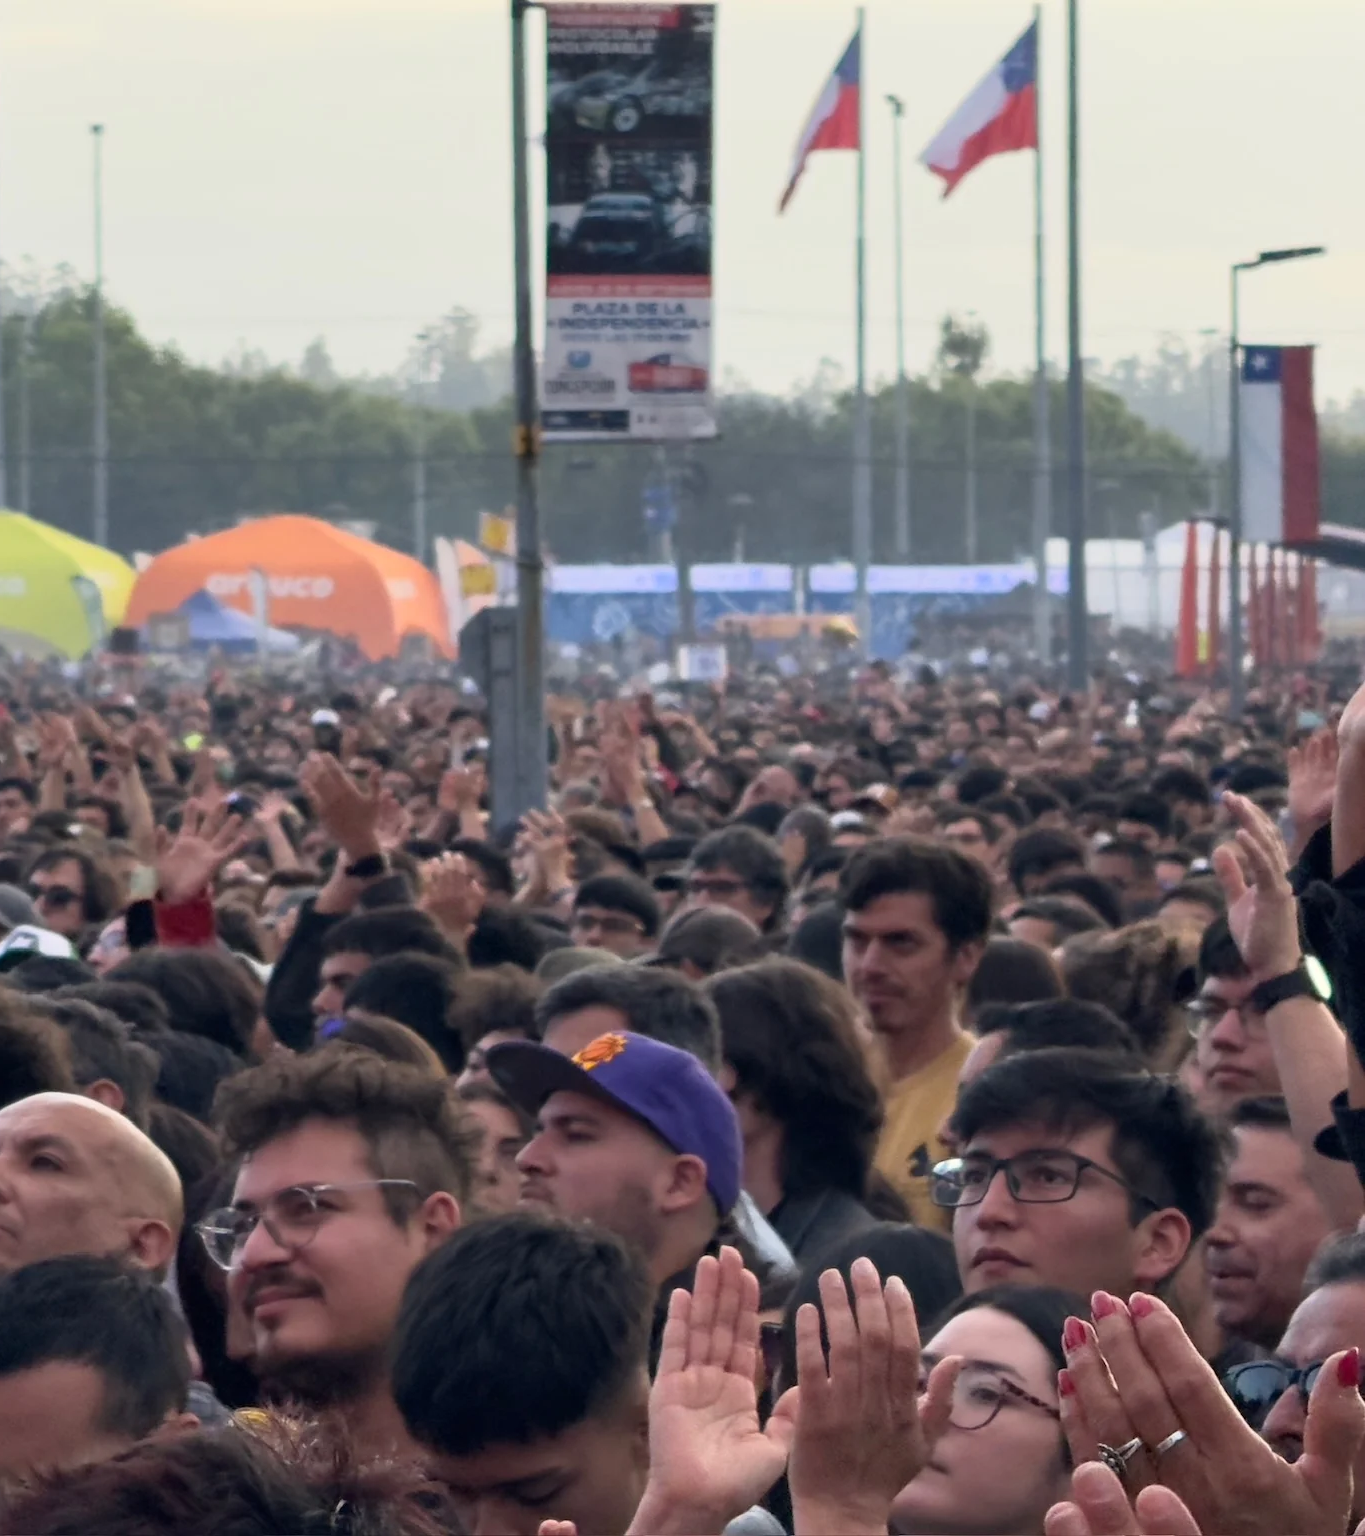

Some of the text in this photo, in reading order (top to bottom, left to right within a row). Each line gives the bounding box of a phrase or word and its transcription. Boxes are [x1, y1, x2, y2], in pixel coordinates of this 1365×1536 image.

[572, 303, 685, 315] PLAZA DE LA
[205, 573, 335, 599] aruco
